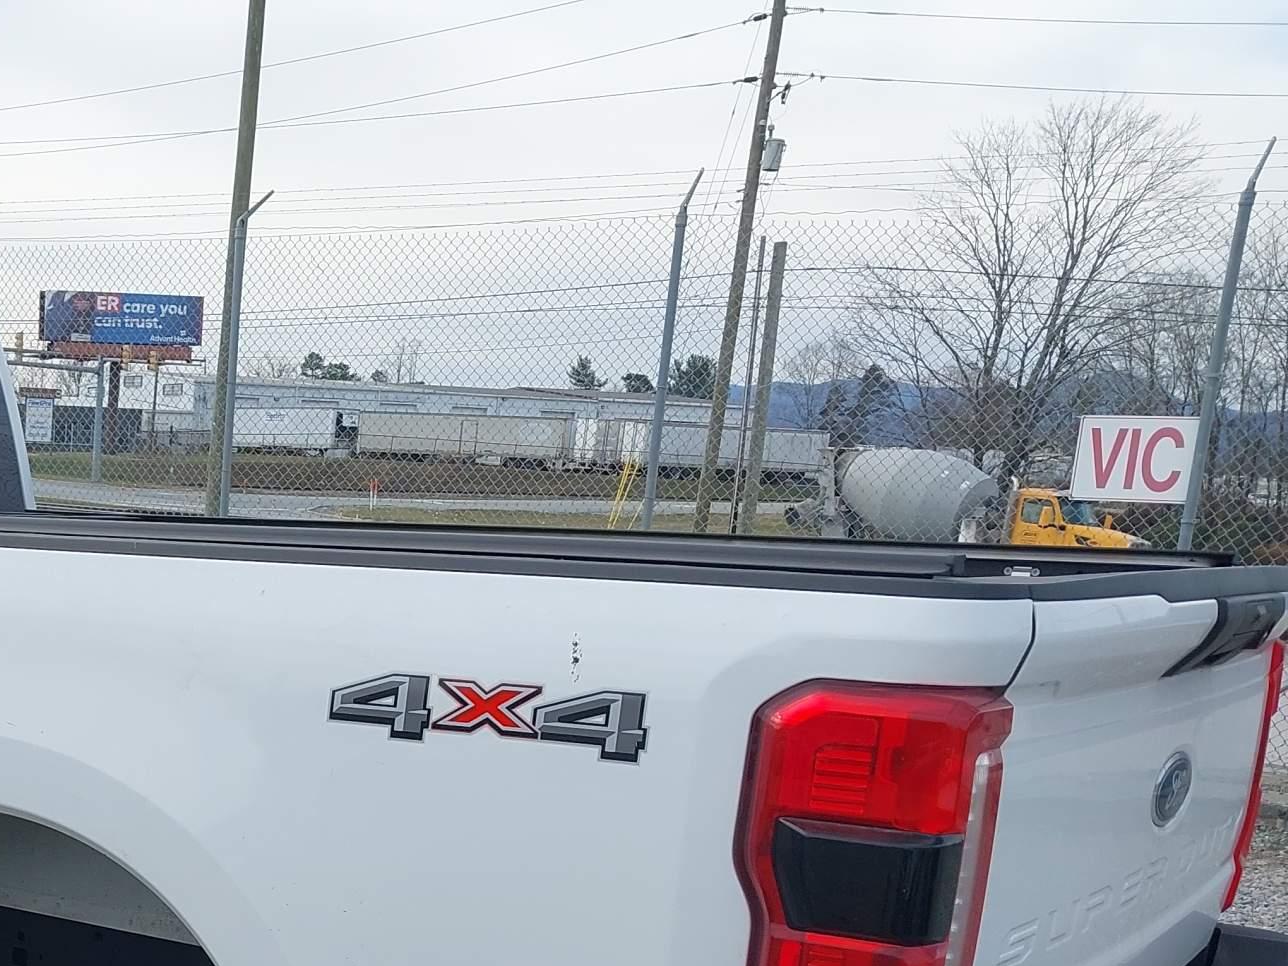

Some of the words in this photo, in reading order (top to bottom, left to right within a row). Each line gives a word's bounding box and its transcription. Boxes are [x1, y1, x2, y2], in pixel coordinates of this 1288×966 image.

[96, 295, 120, 311] ER
[123, 302, 156, 313] care
[160, 303, 188, 317] you
[94, 317, 121, 328] can
[124, 315, 163, 329] trust.
[1092, 427, 1185, 492] VIC
